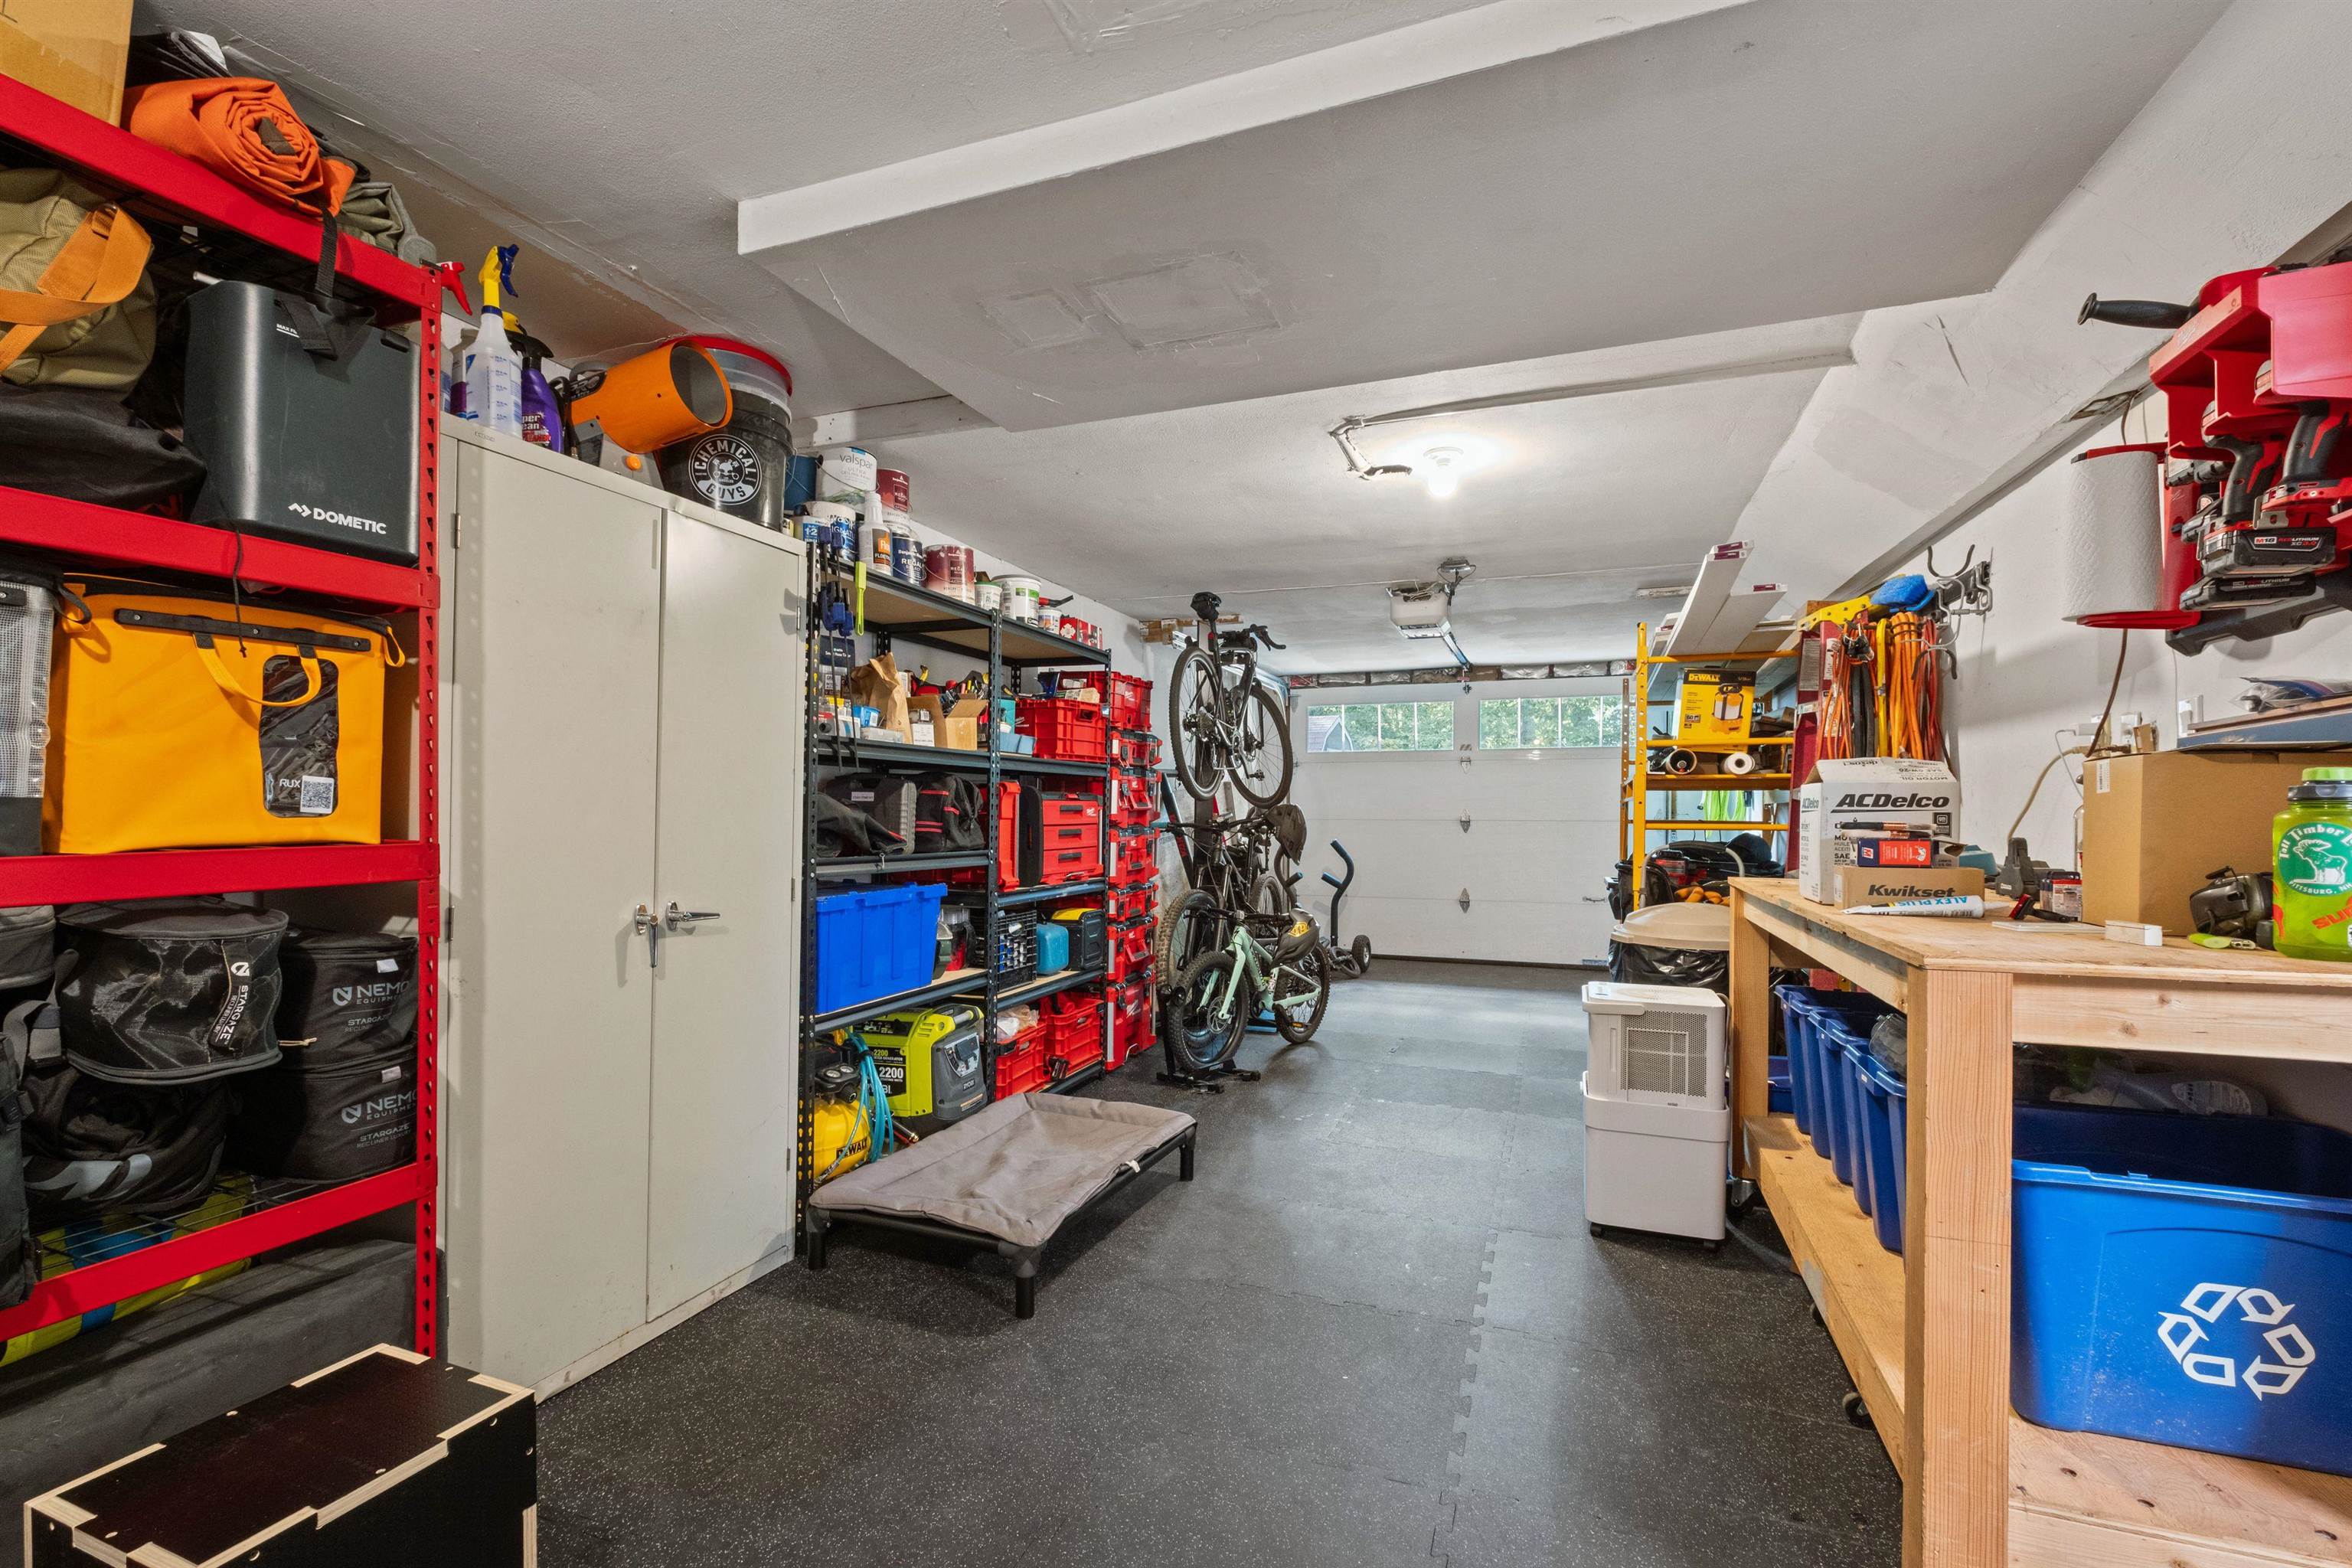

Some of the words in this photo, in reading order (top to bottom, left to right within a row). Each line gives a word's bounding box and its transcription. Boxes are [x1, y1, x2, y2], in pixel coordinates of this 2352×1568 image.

[694, 440, 756, 475] CHEMICAL
[839, 453, 873, 469] valspar
[706, 483, 746, 499] GUYS
[313, 508, 387, 534] DOMETIC
[279, 778, 301, 788] RUX
[1835, 793, 1950, 808] ACDelco
[2287, 824, 2344, 841] Timber
[1868, 884, 1956, 897] Kwikset
[1936, 896, 1968, 906] ALEX
[357, 981, 409, 998] NEMO
[220, 985, 248, 1040] STARGAZE
[879, 1067, 903, 1078] 2200
[360, 1122, 410, 1142] STARGAZE
